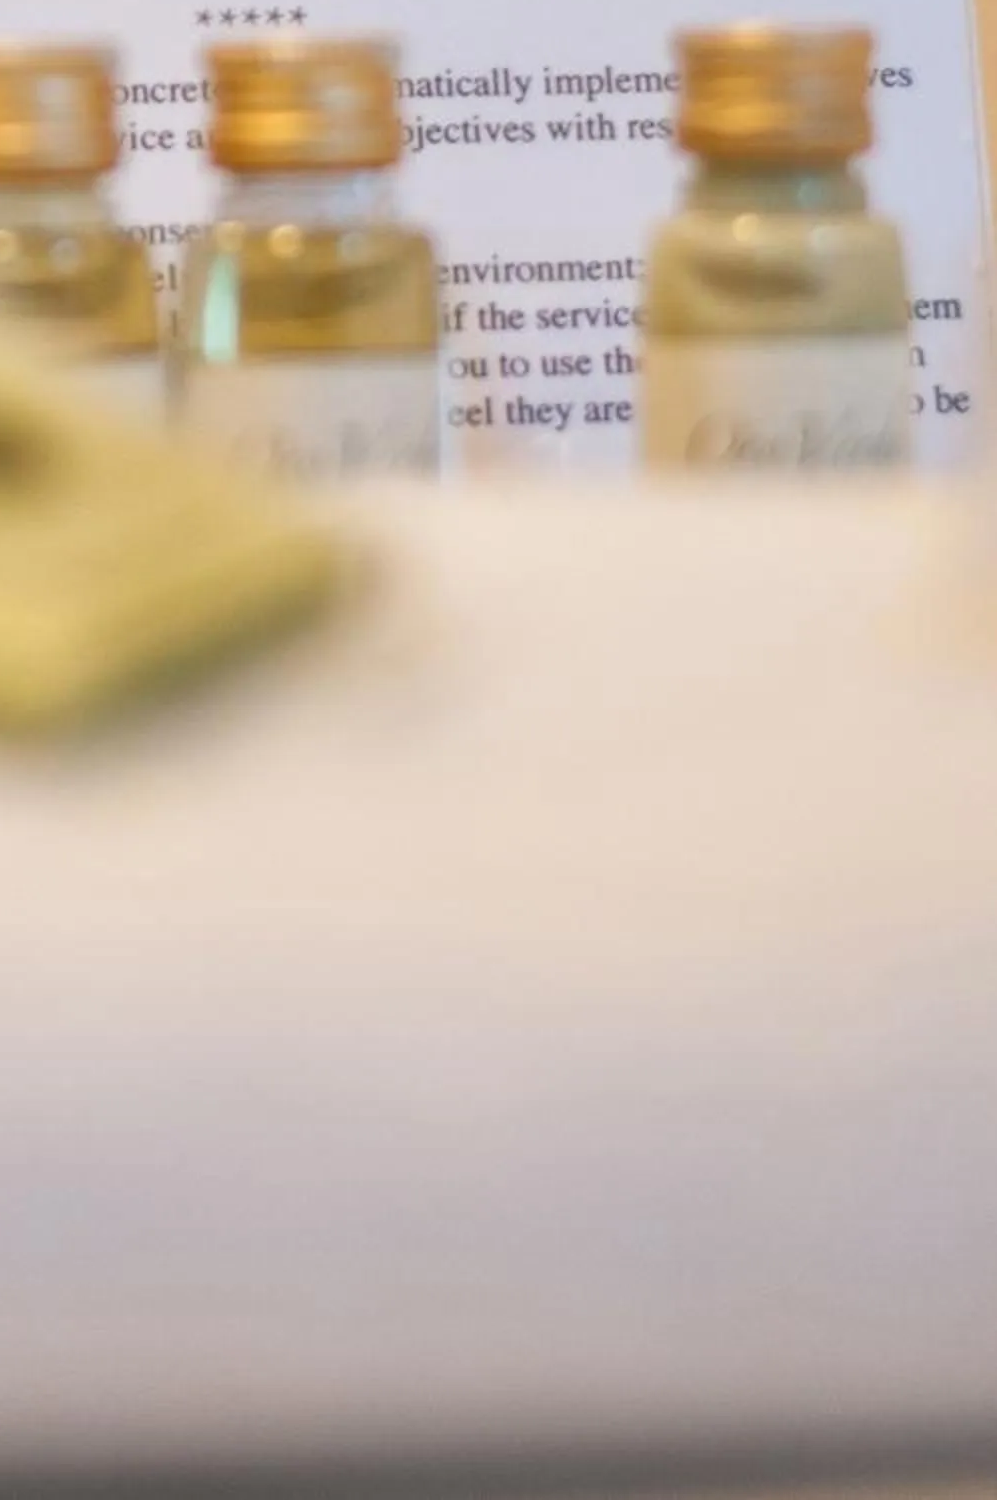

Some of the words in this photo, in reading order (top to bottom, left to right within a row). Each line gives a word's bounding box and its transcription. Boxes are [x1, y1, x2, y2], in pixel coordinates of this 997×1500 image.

[543, 65, 682, 102] impleme
[548, 112, 616, 142] with
[477, 300, 525, 331] the
[499, 352, 531, 378] to
[540, 353, 593, 377] use
[505, 395, 572, 431] they
[583, 399, 634, 423] are
[933, 384, 971, 415] be
